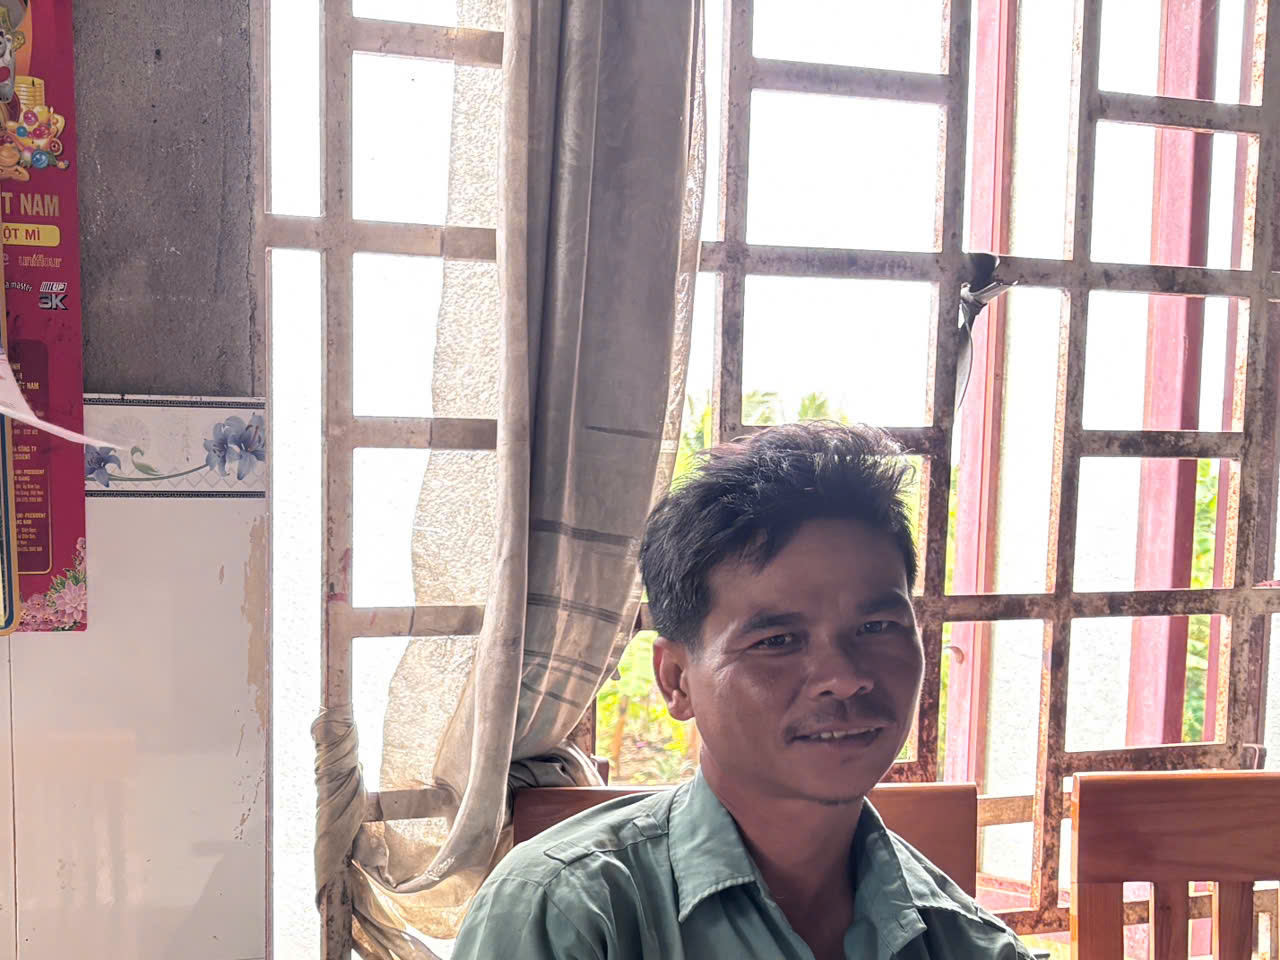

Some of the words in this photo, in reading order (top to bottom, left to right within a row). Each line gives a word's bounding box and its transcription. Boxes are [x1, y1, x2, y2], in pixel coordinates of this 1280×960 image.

[20, 193, 60, 217] NAM
[3, 226, 19, 242] ỘT
[25, 228, 40, 241] MÌ
[39, 294, 68, 311] 3K
